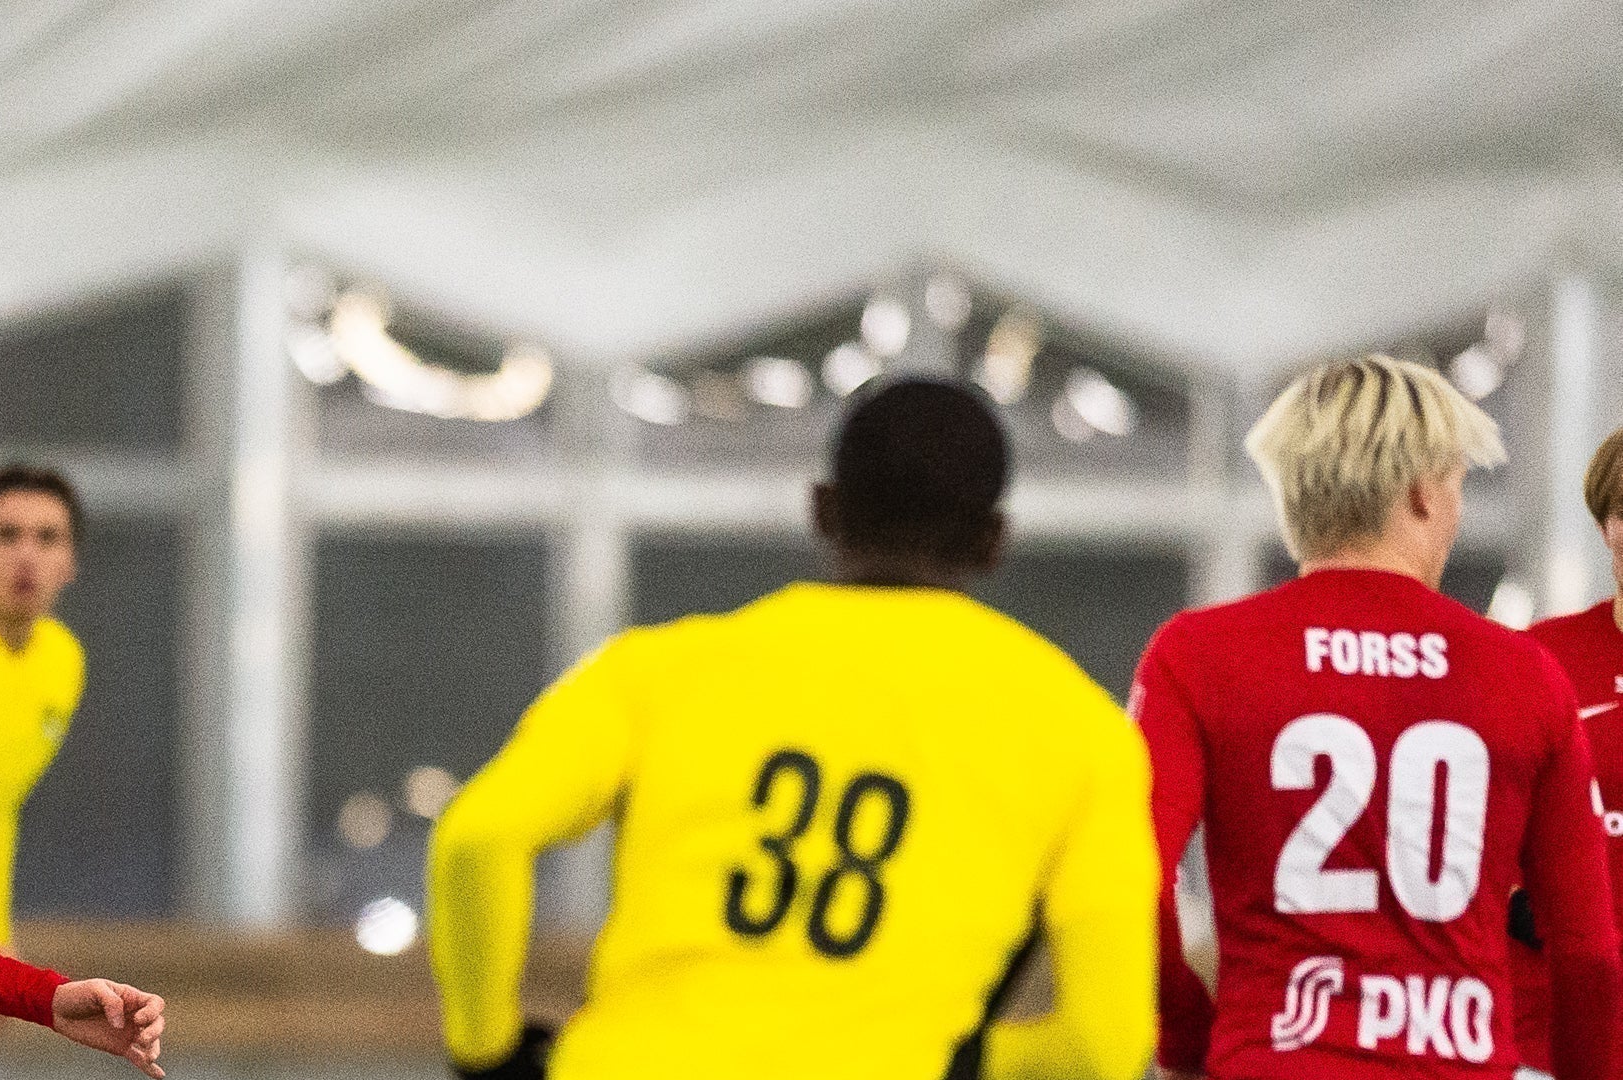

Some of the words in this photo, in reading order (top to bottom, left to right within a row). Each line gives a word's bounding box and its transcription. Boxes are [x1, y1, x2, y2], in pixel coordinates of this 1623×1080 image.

[1303, 626, 1449, 680] FORSS
[725, 749, 911, 956] 38
[1270, 711, 1491, 923] 20
[1356, 973, 1494, 1064] PKO
